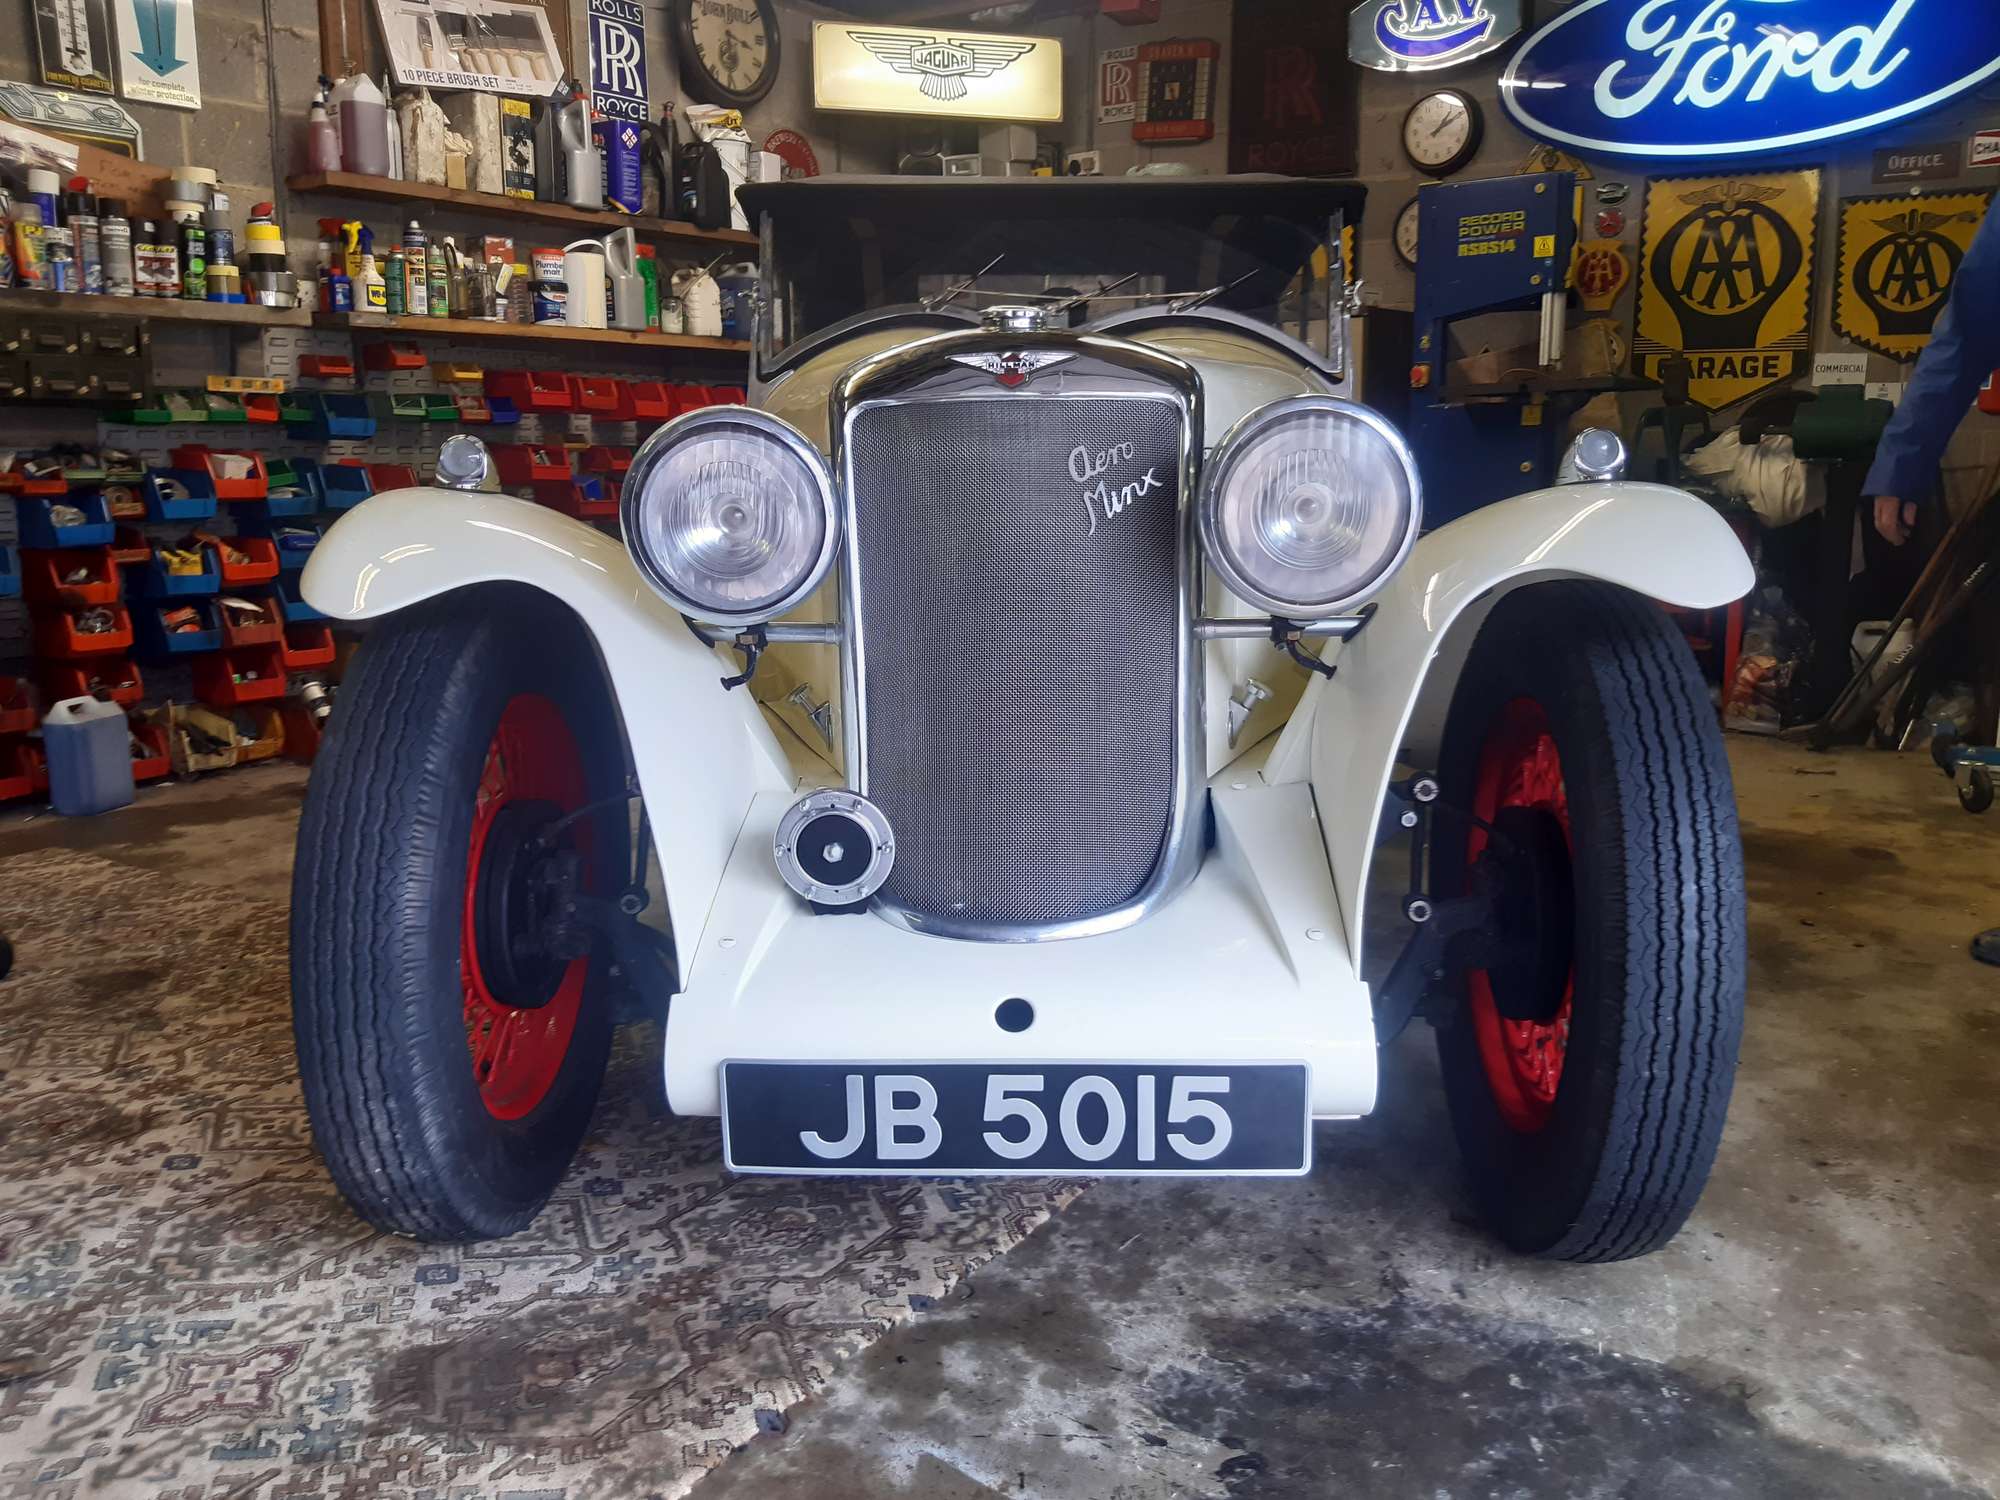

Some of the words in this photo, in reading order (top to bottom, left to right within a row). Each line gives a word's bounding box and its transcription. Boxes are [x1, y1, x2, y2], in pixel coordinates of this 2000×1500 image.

[592, 0, 642, 22] ROLLS
[916, 50, 969, 69] JAGUAR
[1594, 0, 1911, 118] Ford
[152, 80, 186, 92] complete
[402, 69, 415, 81] 10
[417, 70, 445, 84] PIECE
[447, 73, 481, 87] BRUSH
[482, 77, 500, 89] SET
[596, 96, 648, 120] ROYCE
[1888, 153, 1944, 170] OFFICE
[1459, 210, 1526, 227] RECORD
[1459, 222, 1526, 238] POWER
[987, 361, 1036, 369] HILLMAN
[1815, 363, 1865, 375] COMMERCIAL
[1068, 441, 1134, 483] Aero
[799, 1074, 943, 1160] JB
[982, 1074, 1233, 1162] 5015
